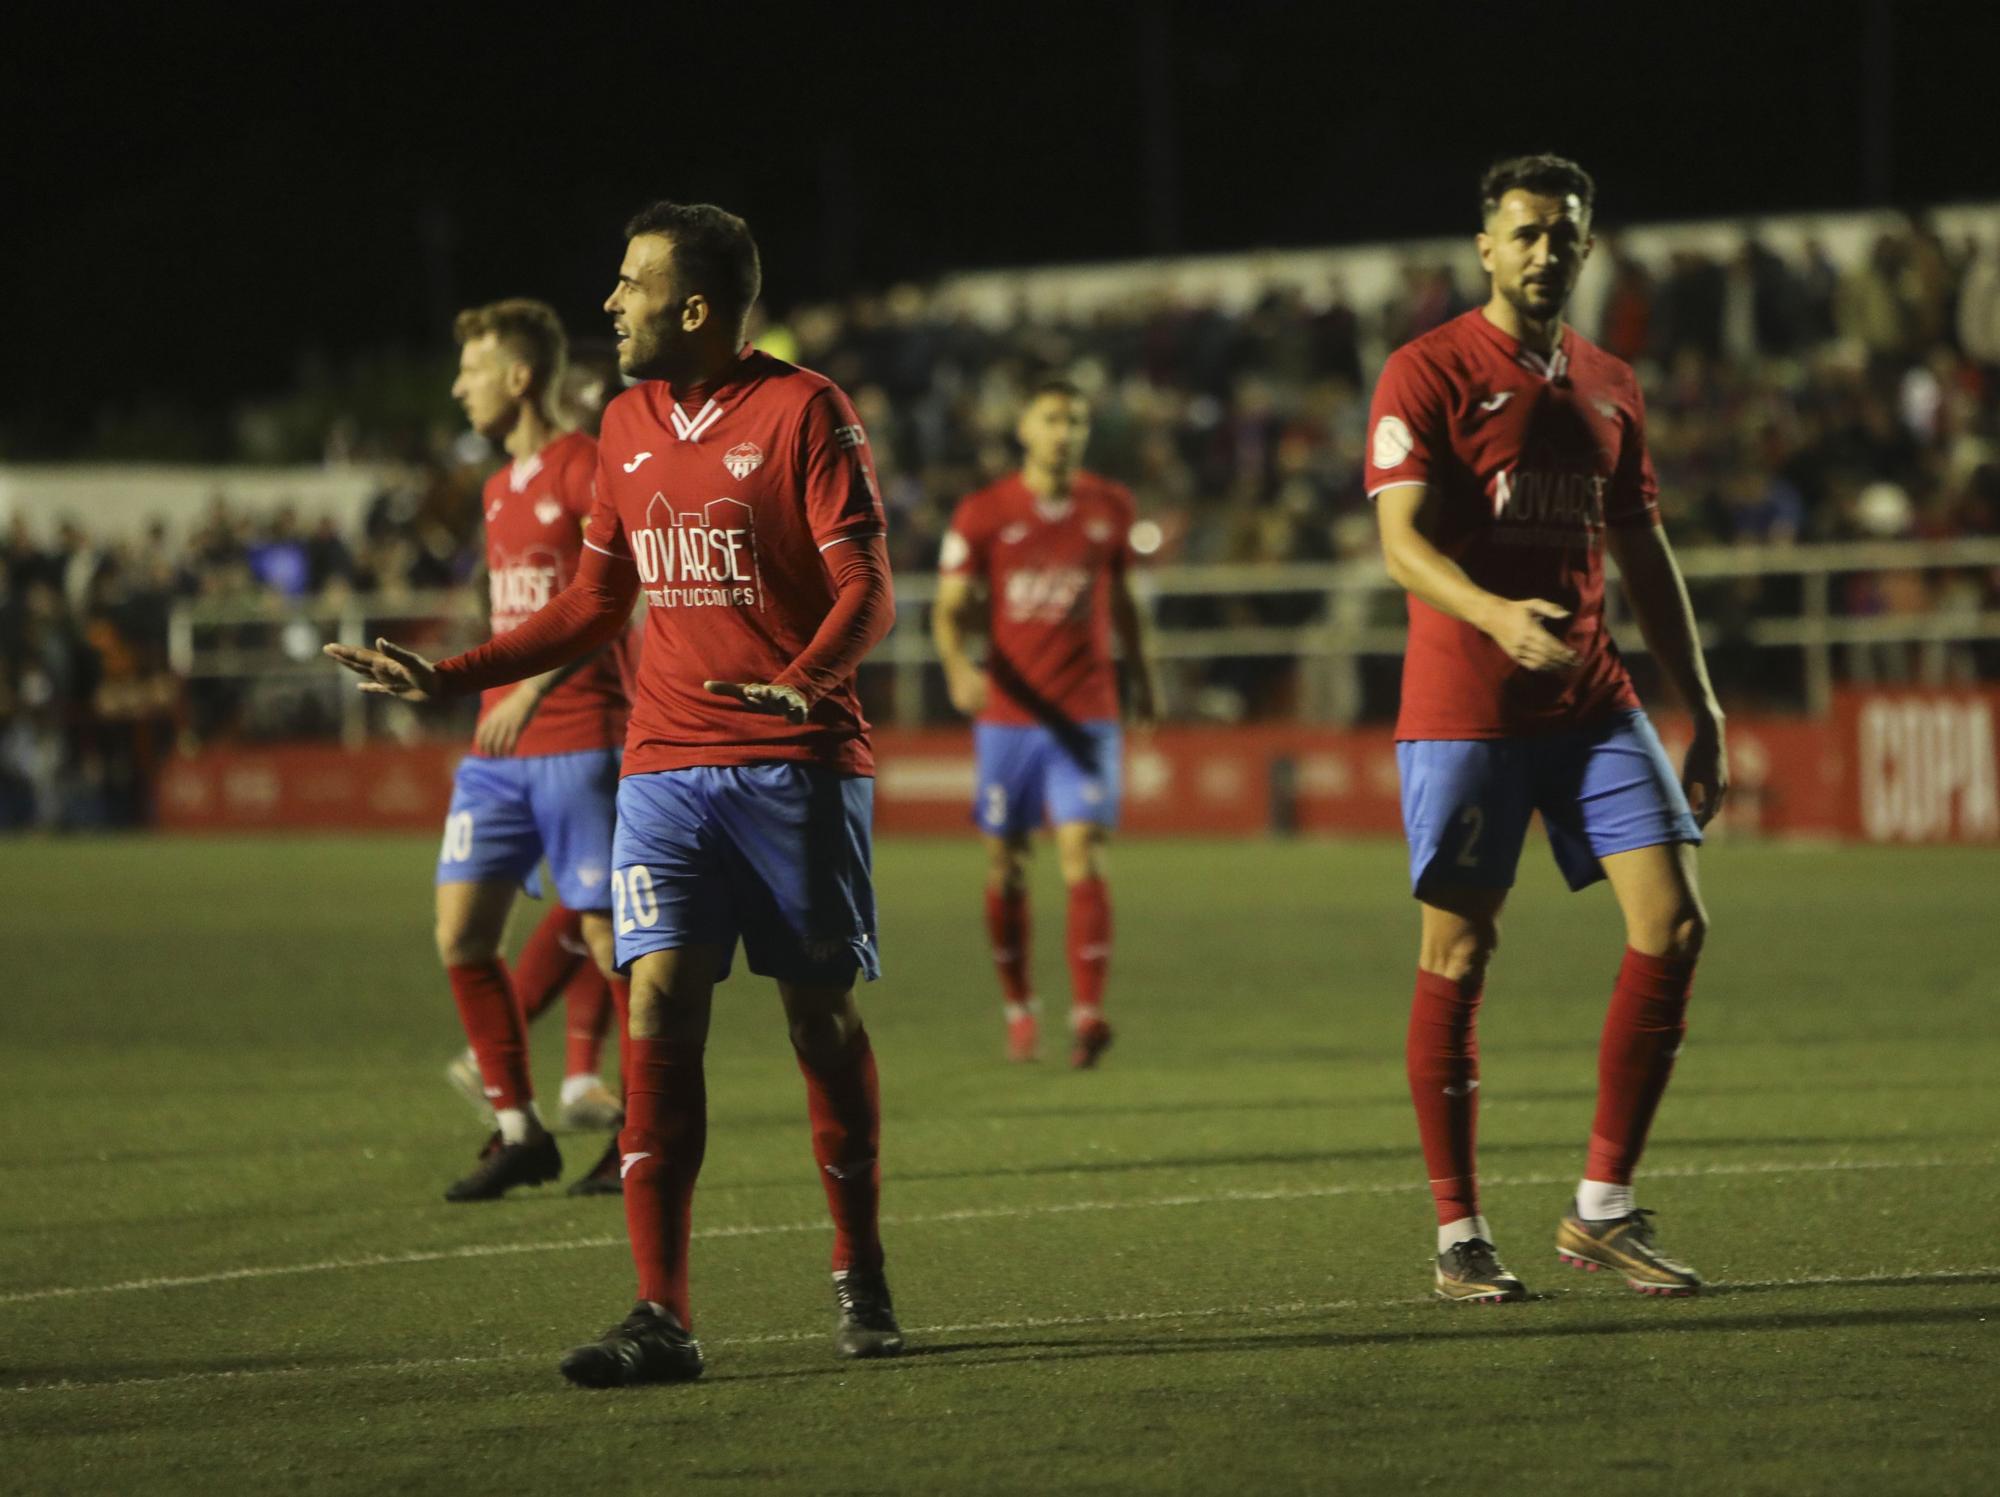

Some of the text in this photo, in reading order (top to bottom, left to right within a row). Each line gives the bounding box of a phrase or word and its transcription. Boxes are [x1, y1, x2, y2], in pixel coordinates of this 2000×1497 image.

[631, 526, 752, 584] NOVARSE
[1858, 698, 1999, 841] COPA
[1456, 804, 1484, 868] 2
[611, 864, 660, 936] 20
